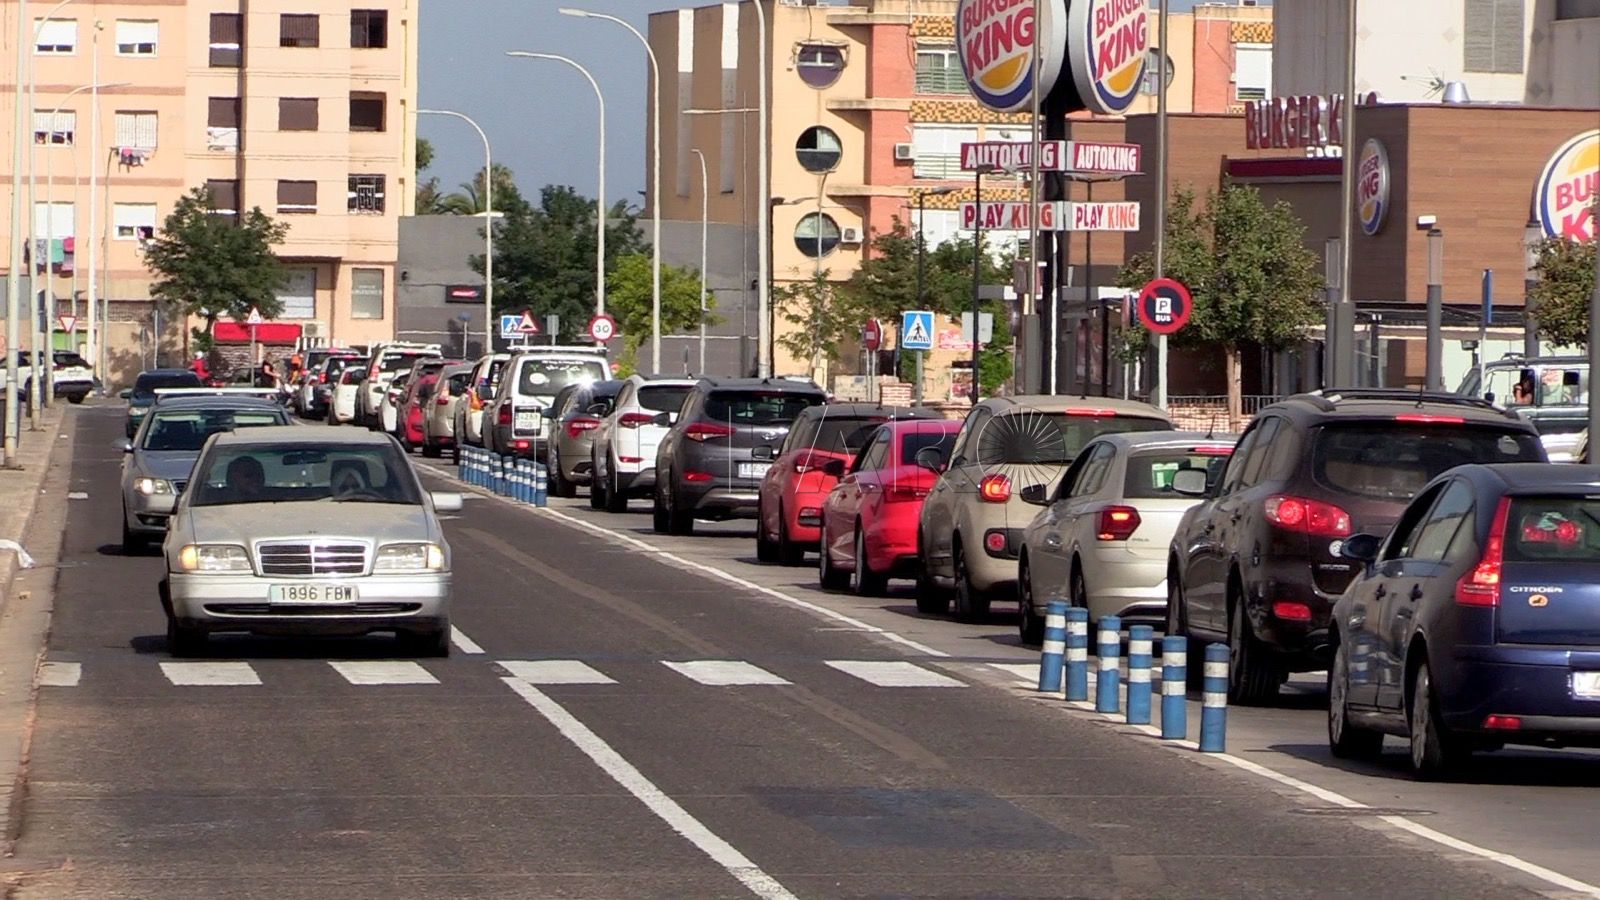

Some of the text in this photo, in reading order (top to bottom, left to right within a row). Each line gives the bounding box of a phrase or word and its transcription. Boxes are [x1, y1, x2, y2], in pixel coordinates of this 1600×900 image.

[964, 0, 1024, 38] BUR
[1096, 0, 1145, 38] BUR
[966, 7, 1034, 81] KING
[1096, 12, 1146, 81] KING
[1246, 95, 1328, 149] BURGER
[1076, 144, 1137, 171] AUTOKING
[1011, 203, 1052, 228] KIG
[1075, 204, 1136, 229] PLAY KING
[1155, 314, 1171, 322] BUS
[1159, 301, 1168, 312] P
[595, 325, 610, 334] 30
[280, 586, 352, 601] 1896 FBW
